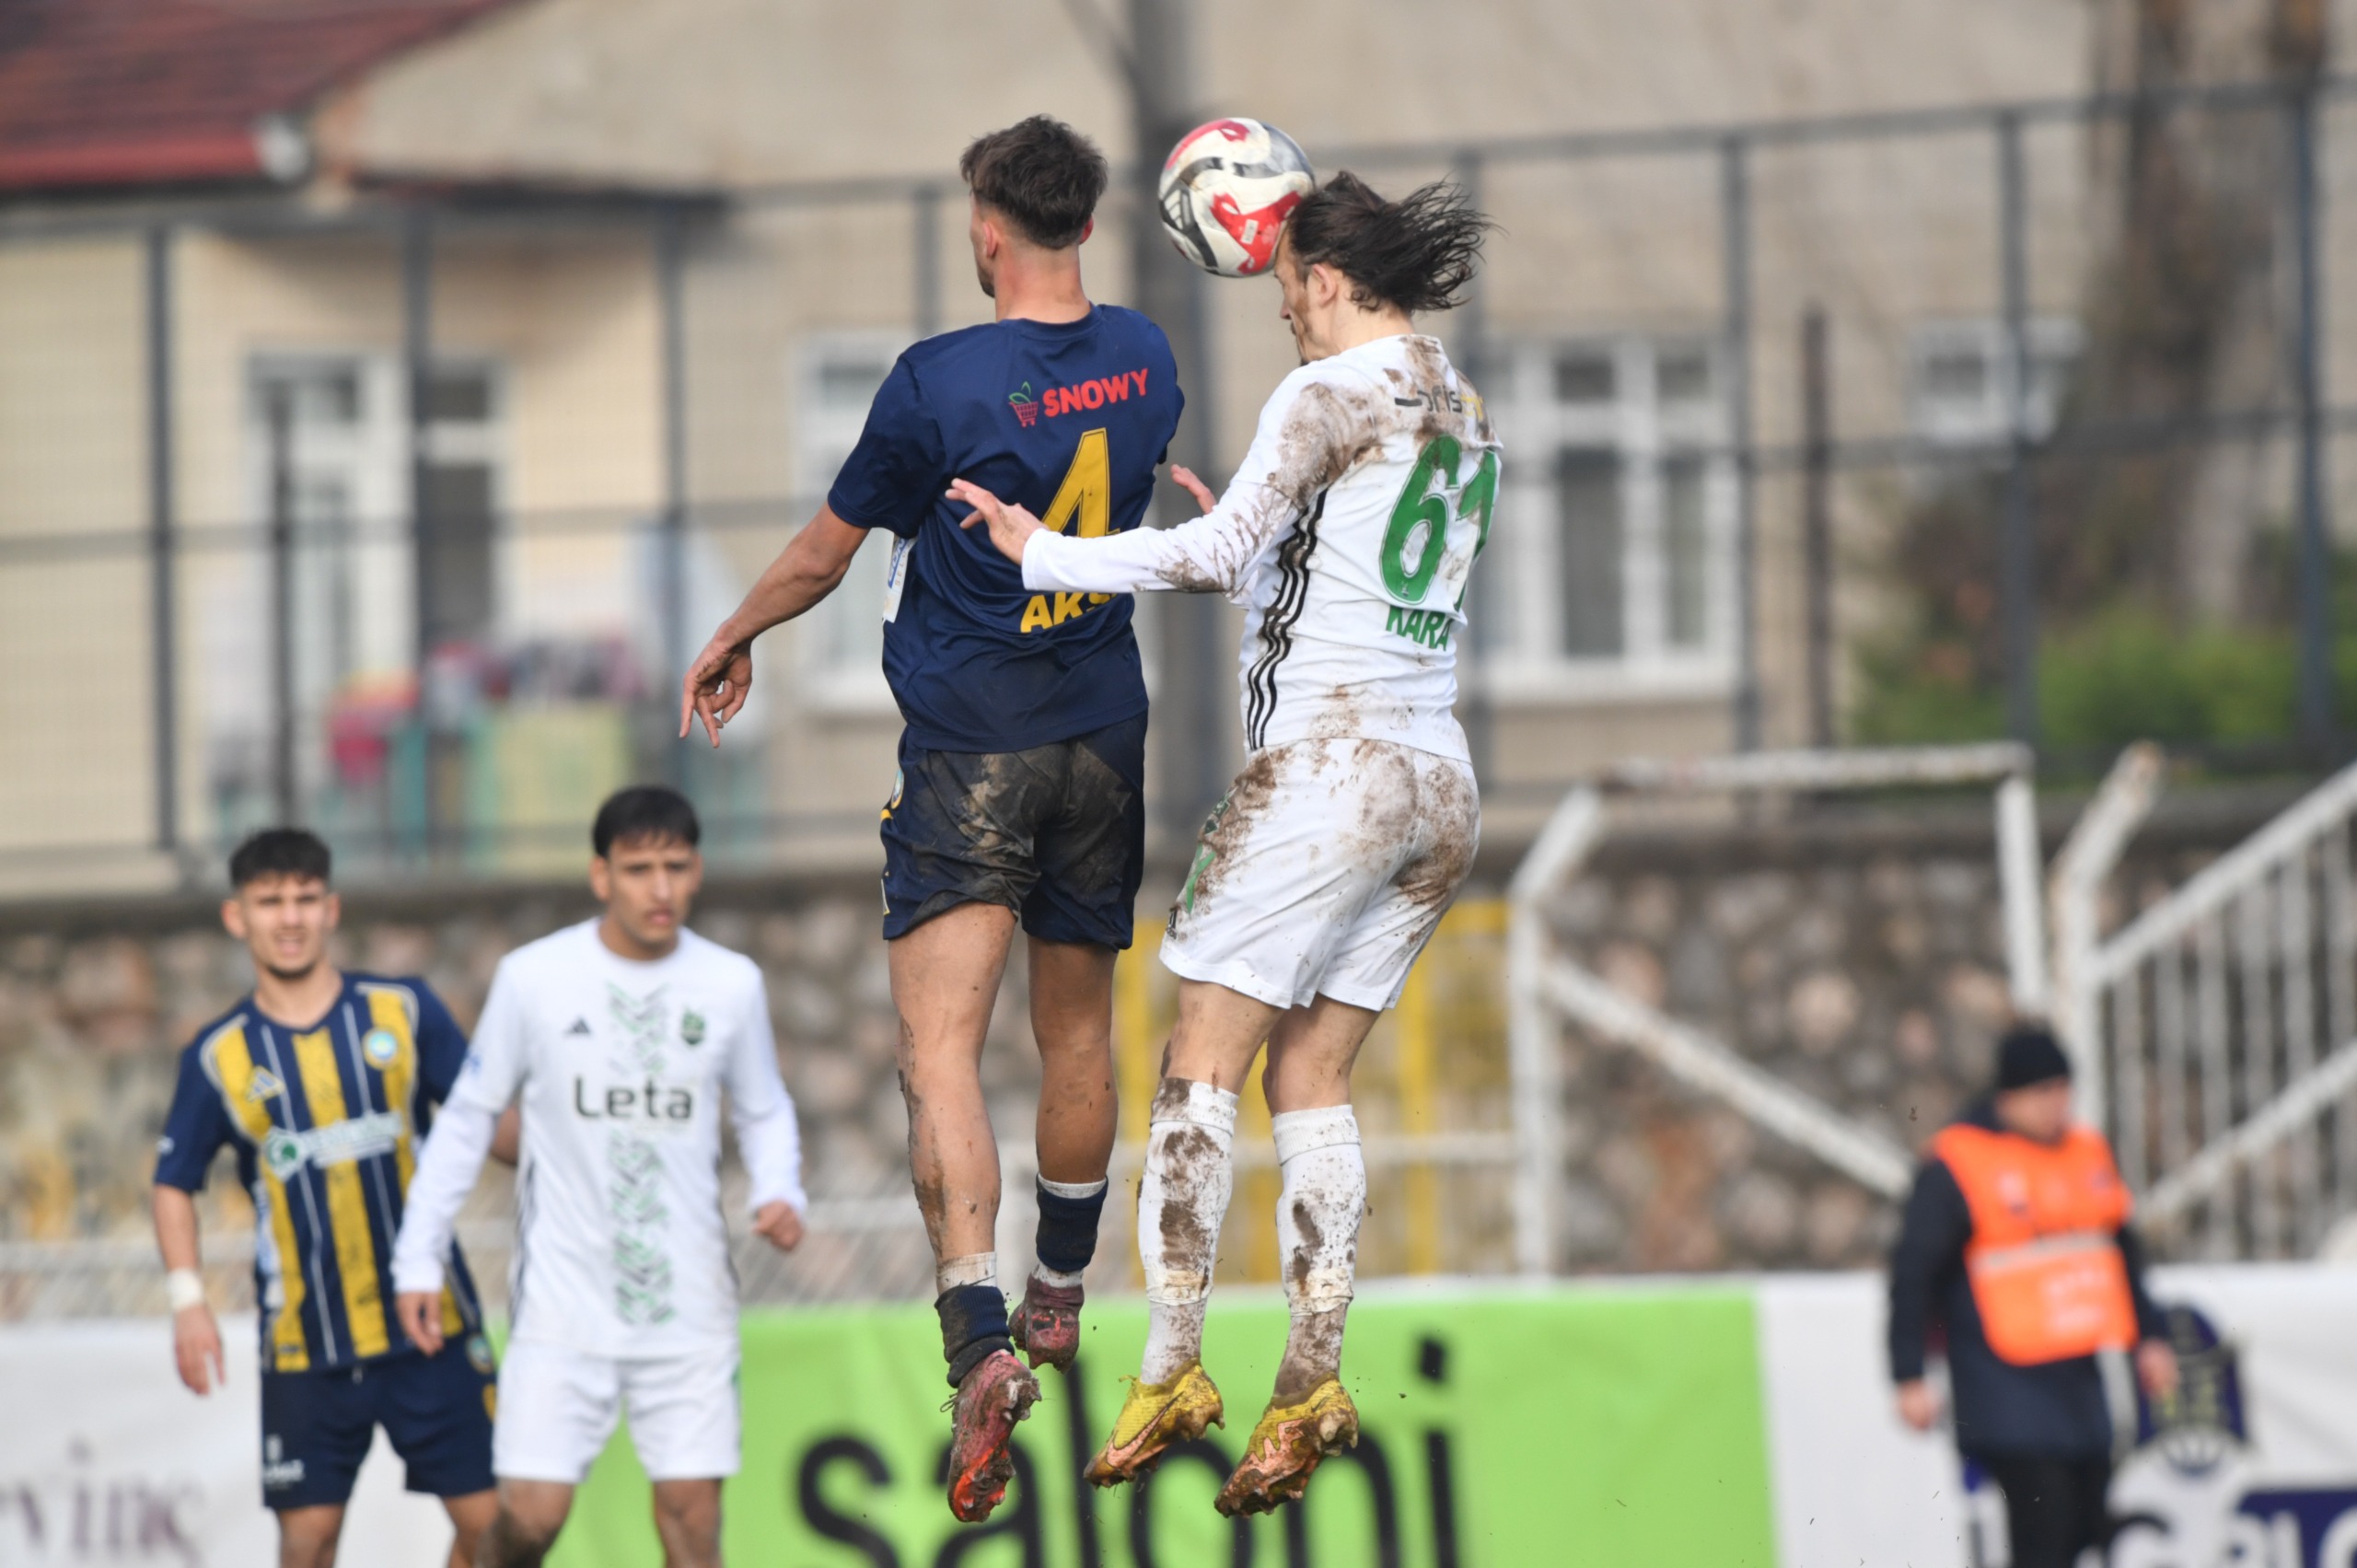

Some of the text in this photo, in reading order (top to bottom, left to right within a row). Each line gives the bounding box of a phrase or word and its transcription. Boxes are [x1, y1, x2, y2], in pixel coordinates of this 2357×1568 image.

[1042, 368, 1148, 417] SNOWY
[1040, 426, 1120, 539] 4
[1379, 434, 1497, 613] 61
[575, 1075, 694, 1120] Leta
